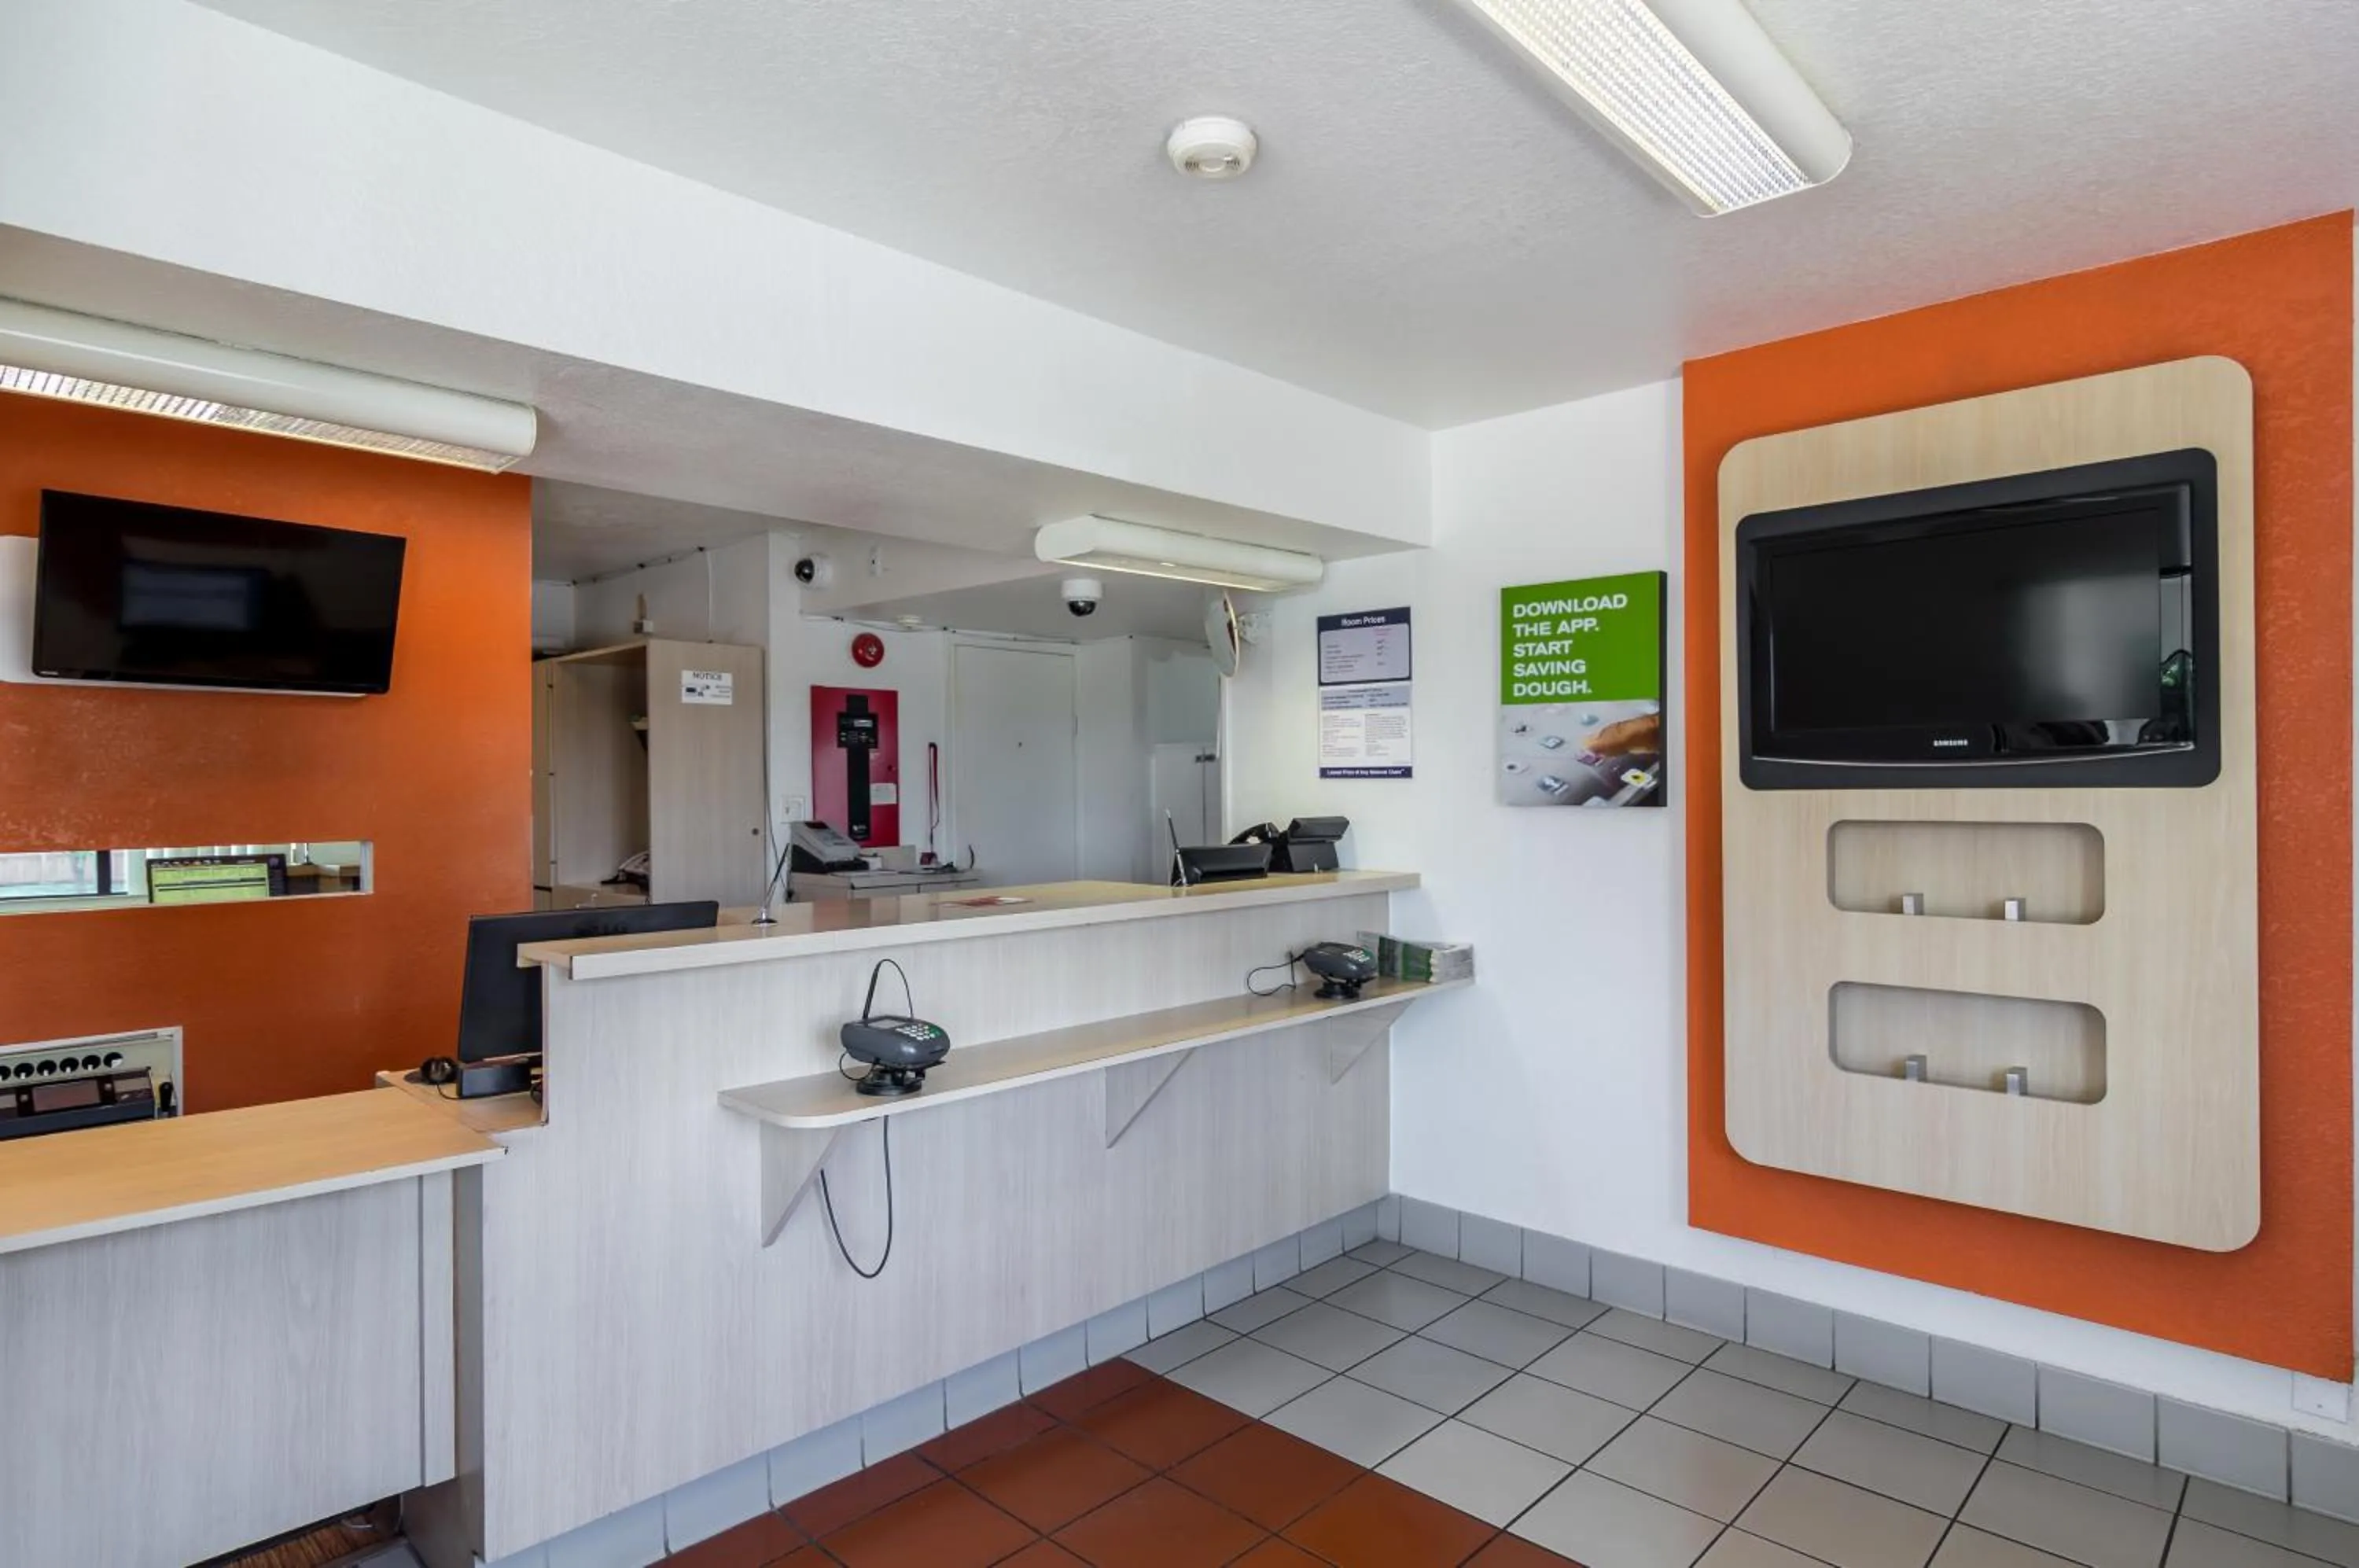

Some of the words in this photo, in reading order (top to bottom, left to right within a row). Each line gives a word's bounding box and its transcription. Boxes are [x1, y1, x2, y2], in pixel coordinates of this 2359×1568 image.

[1512, 594, 1628, 618] DOWNLOAD
[1513, 621, 1551, 638] THE
[1557, 617, 1599, 635] APP.
[1513, 639, 1573, 658] START
[1513, 659, 1586, 678] SAVING
[1513, 679, 1592, 698] DOUGH.
